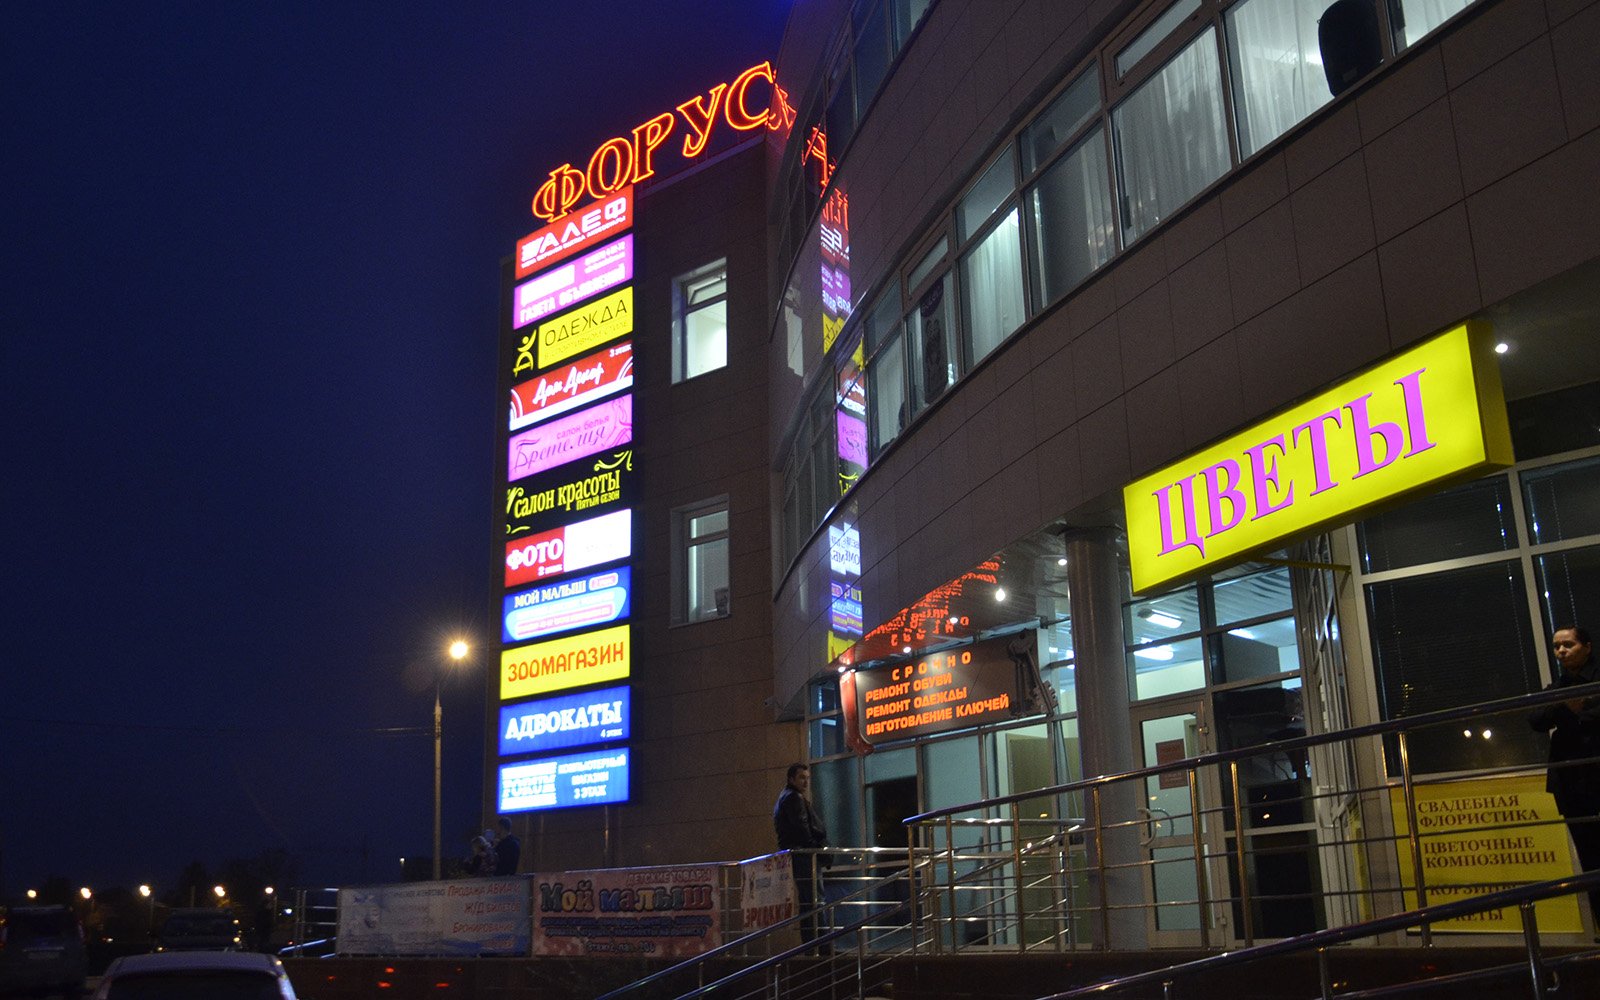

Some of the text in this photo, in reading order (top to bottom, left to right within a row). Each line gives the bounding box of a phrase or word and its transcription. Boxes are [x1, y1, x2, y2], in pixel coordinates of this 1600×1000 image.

[531, 60, 774, 223] ФОРУС
[540, 196, 627, 255] АЛЕФ
[544, 299, 628, 347] ОДЕЖДА
[556, 426, 581, 440] салон
[1152, 367, 1437, 559] ЦВЕТЫ
[557, 469, 621, 512] красоты
[506, 538, 564, 571] ФОТО
[514, 589, 540, 609] МОЙ
[541, 580, 587, 603] МАЛЫШ
[507, 641, 625, 683] ЗООМАГАЗИН
[891, 651, 972, 681] СРОЧНО
[865, 672, 953, 703] РЕМОНТ ОБУВИ
[865, 686, 968, 719] РЕМОНТ ОДЕЖДЫ
[504, 700, 623, 742] АДВОКАТЫ
[866, 693, 1010, 736] ИЗГОТОВЛЕНИЕ КЛЮЧЕЙ
[600, 729, 606, 738] 4
[1417, 795, 1520, 814] СВАДЕБНАЯ
[1419, 809, 1540, 828] ФЛОРИСТИКА
[1424, 836, 1536, 855] ЦВЕТОЧНЫЕ
[1426, 850, 1557, 869] КОМПОЗИЦИИ
[599, 885, 714, 913] малыш
